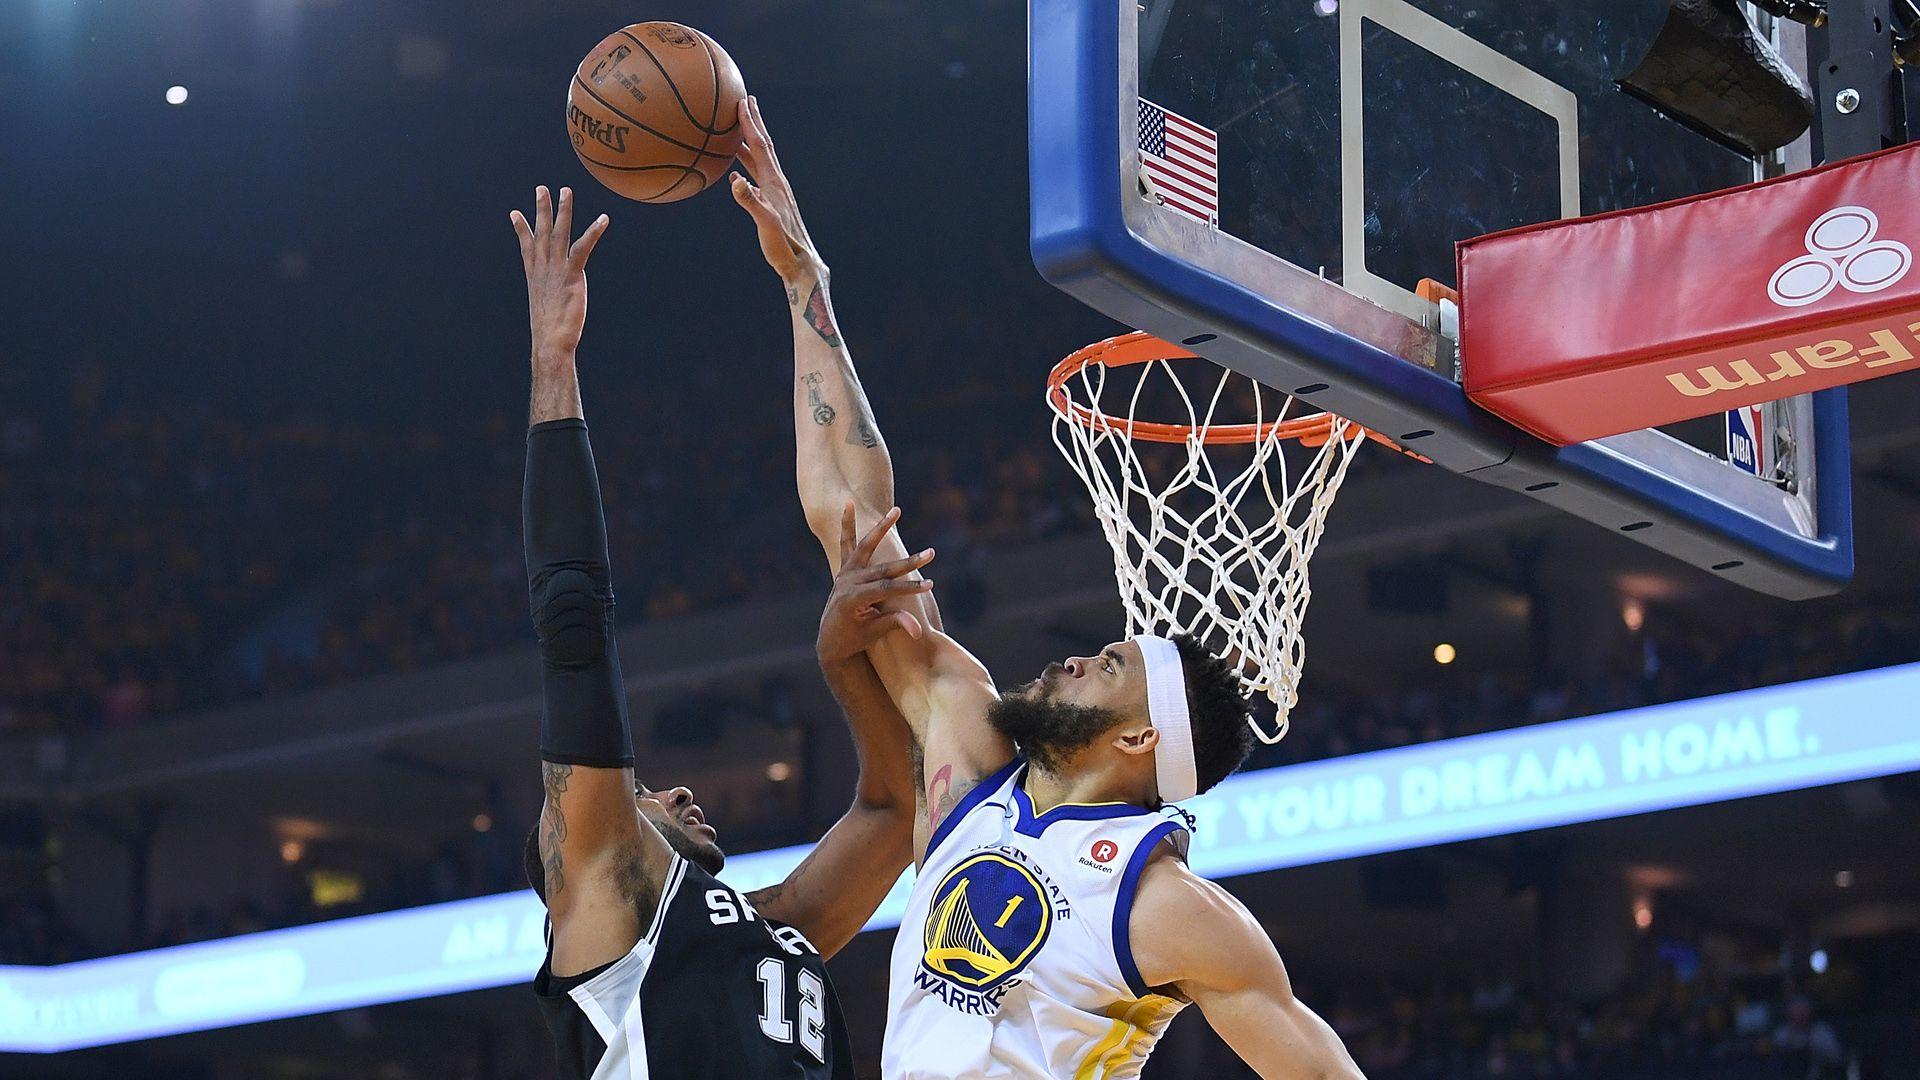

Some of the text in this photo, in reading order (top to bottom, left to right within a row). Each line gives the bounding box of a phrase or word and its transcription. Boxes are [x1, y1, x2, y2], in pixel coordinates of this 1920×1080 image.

[1664, 328, 1915, 397] Farm
[1732, 432, 1752, 466] NBA
[1240, 777, 1386, 836] YOUR
[1404, 745, 1603, 813] DREAM
[1621, 706, 1819, 779] HOME.
[1078, 856, 1113, 874] Rakuten
[1096, 843, 1112, 860] R
[993, 894, 1025, 928] 1
[756, 957, 826, 1065] 12
